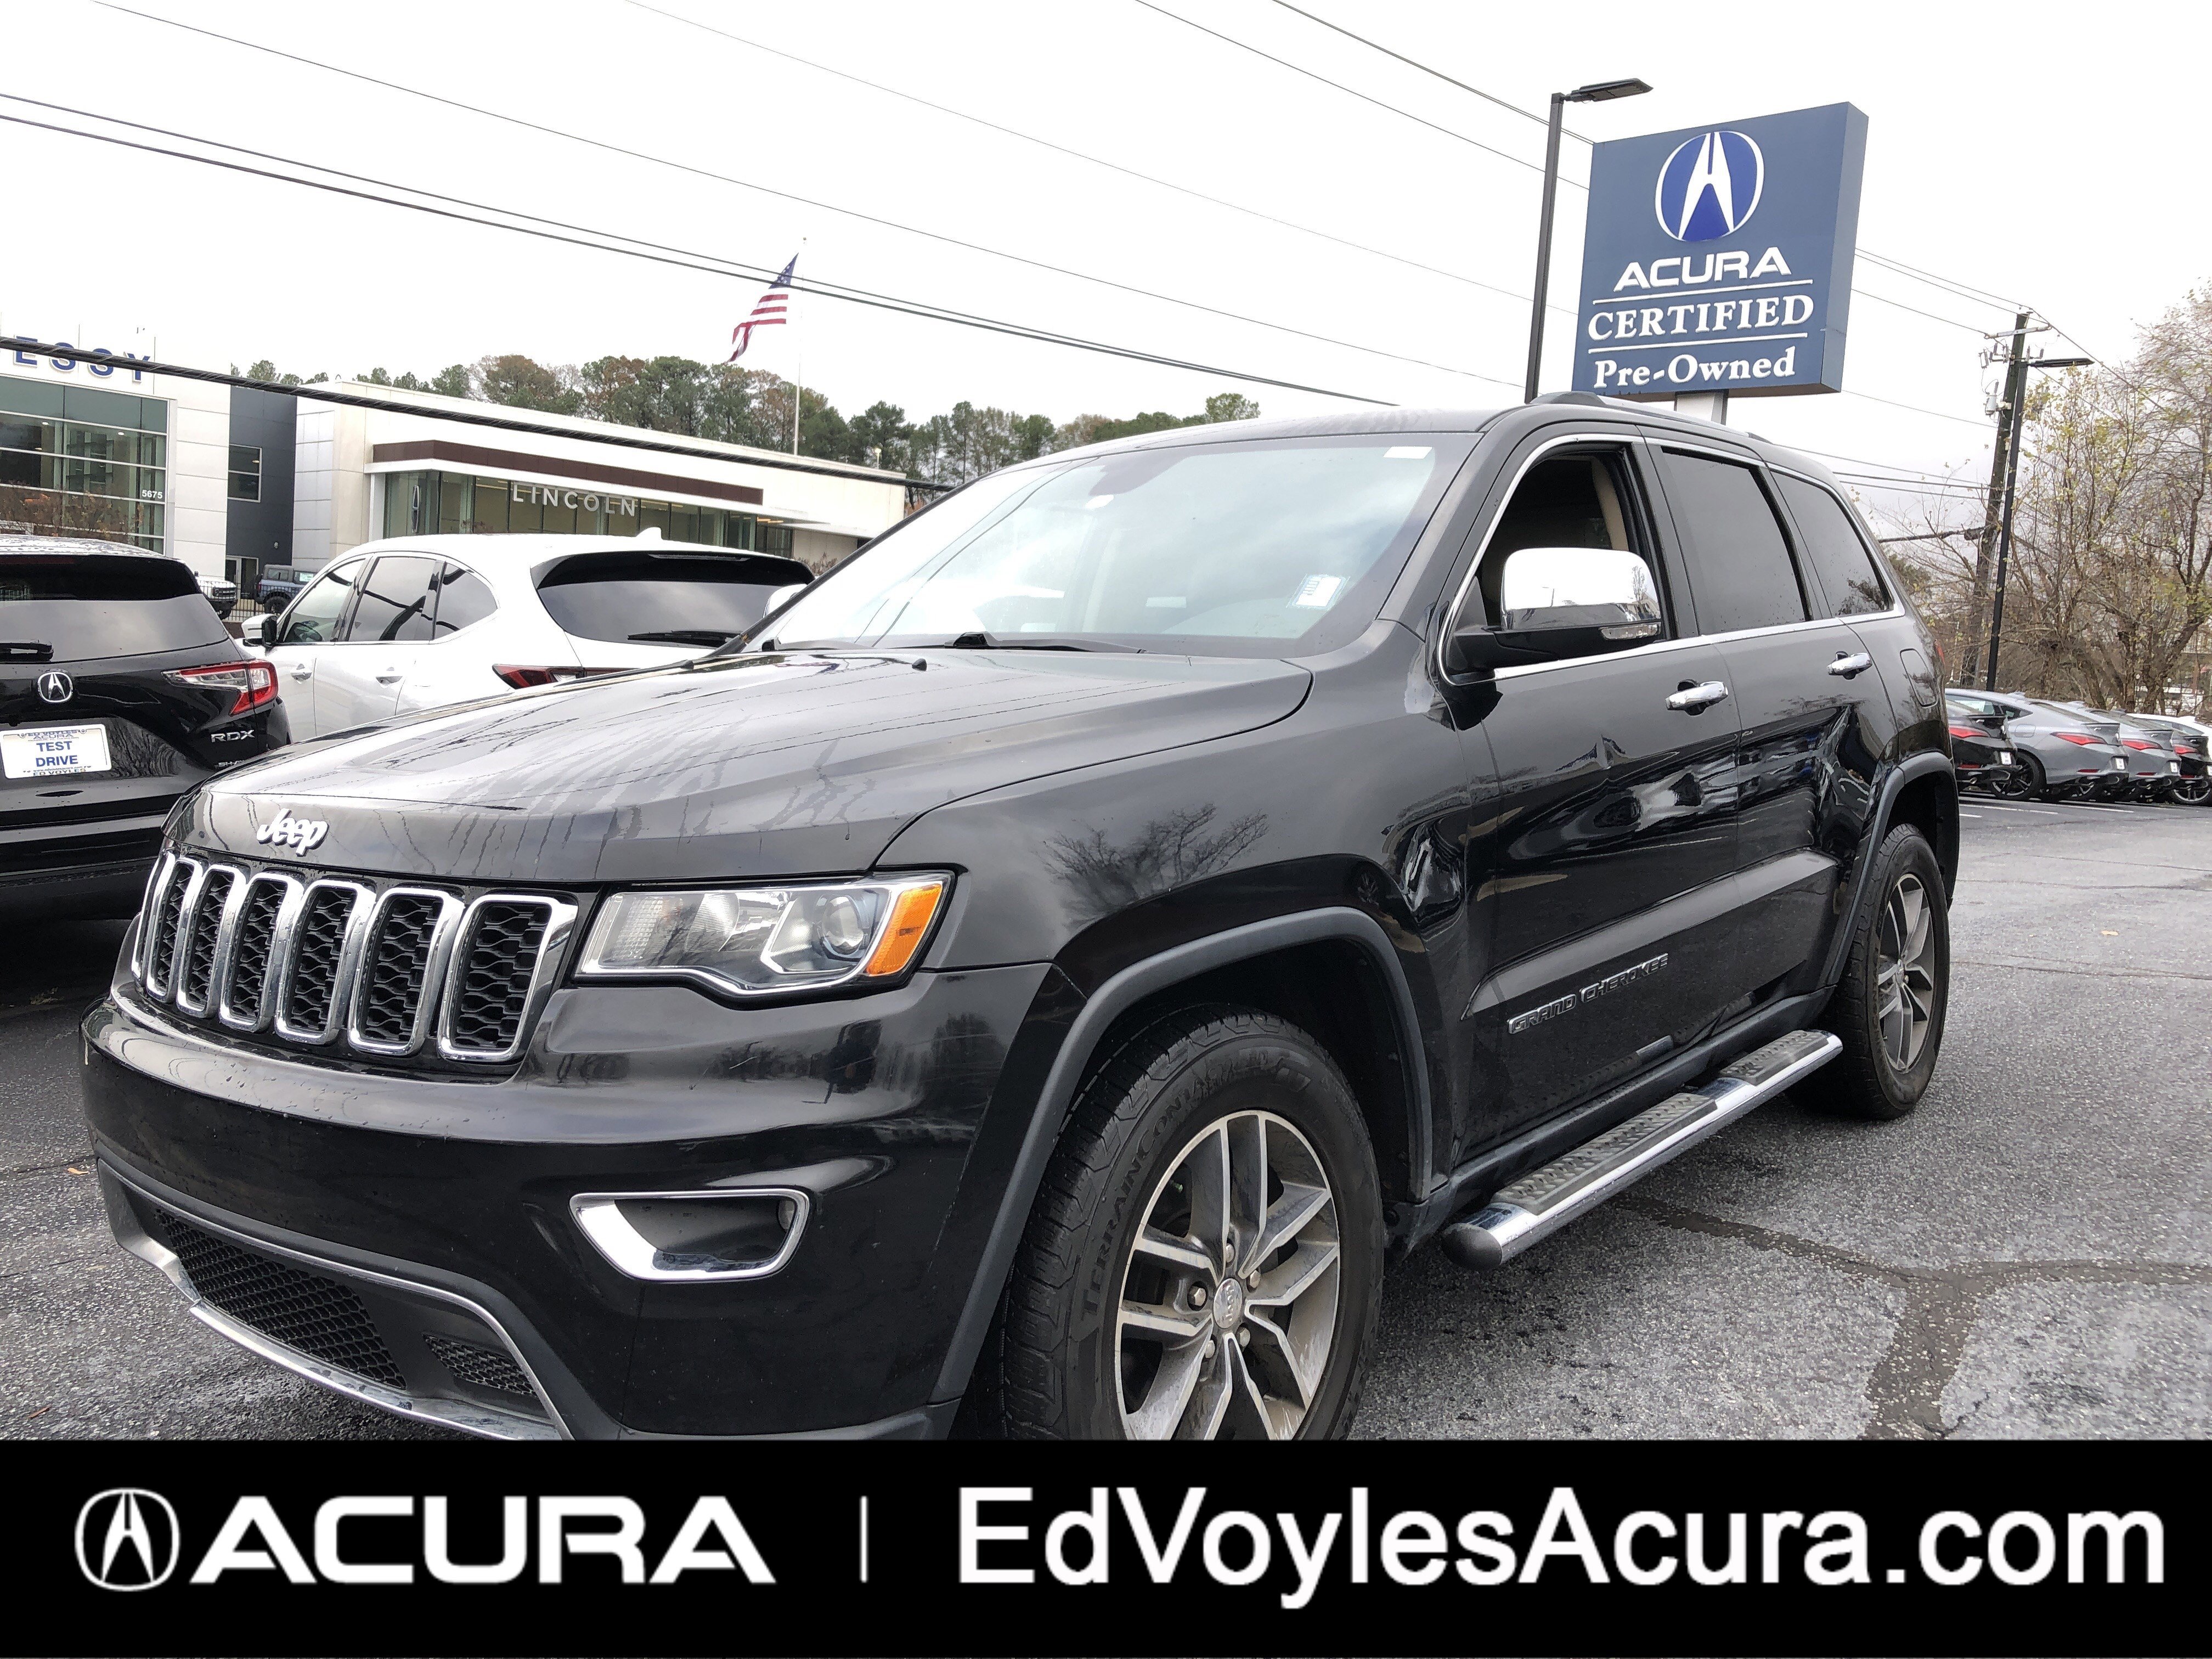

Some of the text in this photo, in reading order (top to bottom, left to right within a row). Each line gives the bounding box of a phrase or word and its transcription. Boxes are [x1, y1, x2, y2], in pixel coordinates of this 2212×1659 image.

[1613, 246, 1792, 292] ACURA
[1588, 295, 1814, 341] CERTIFIED
[1593, 345, 1796, 388] Pre-Owned
[142, 489, 163, 499] 5675
[513, 483, 635, 517] LINCOLN
[36, 741, 72, 752] TEST
[211, 729, 255, 743] RDX
[36, 755, 78, 767] DRIVE
[257, 808, 329, 857] Jeep
[1508, 952, 1669, 1034] GRAND CHEROKEE
